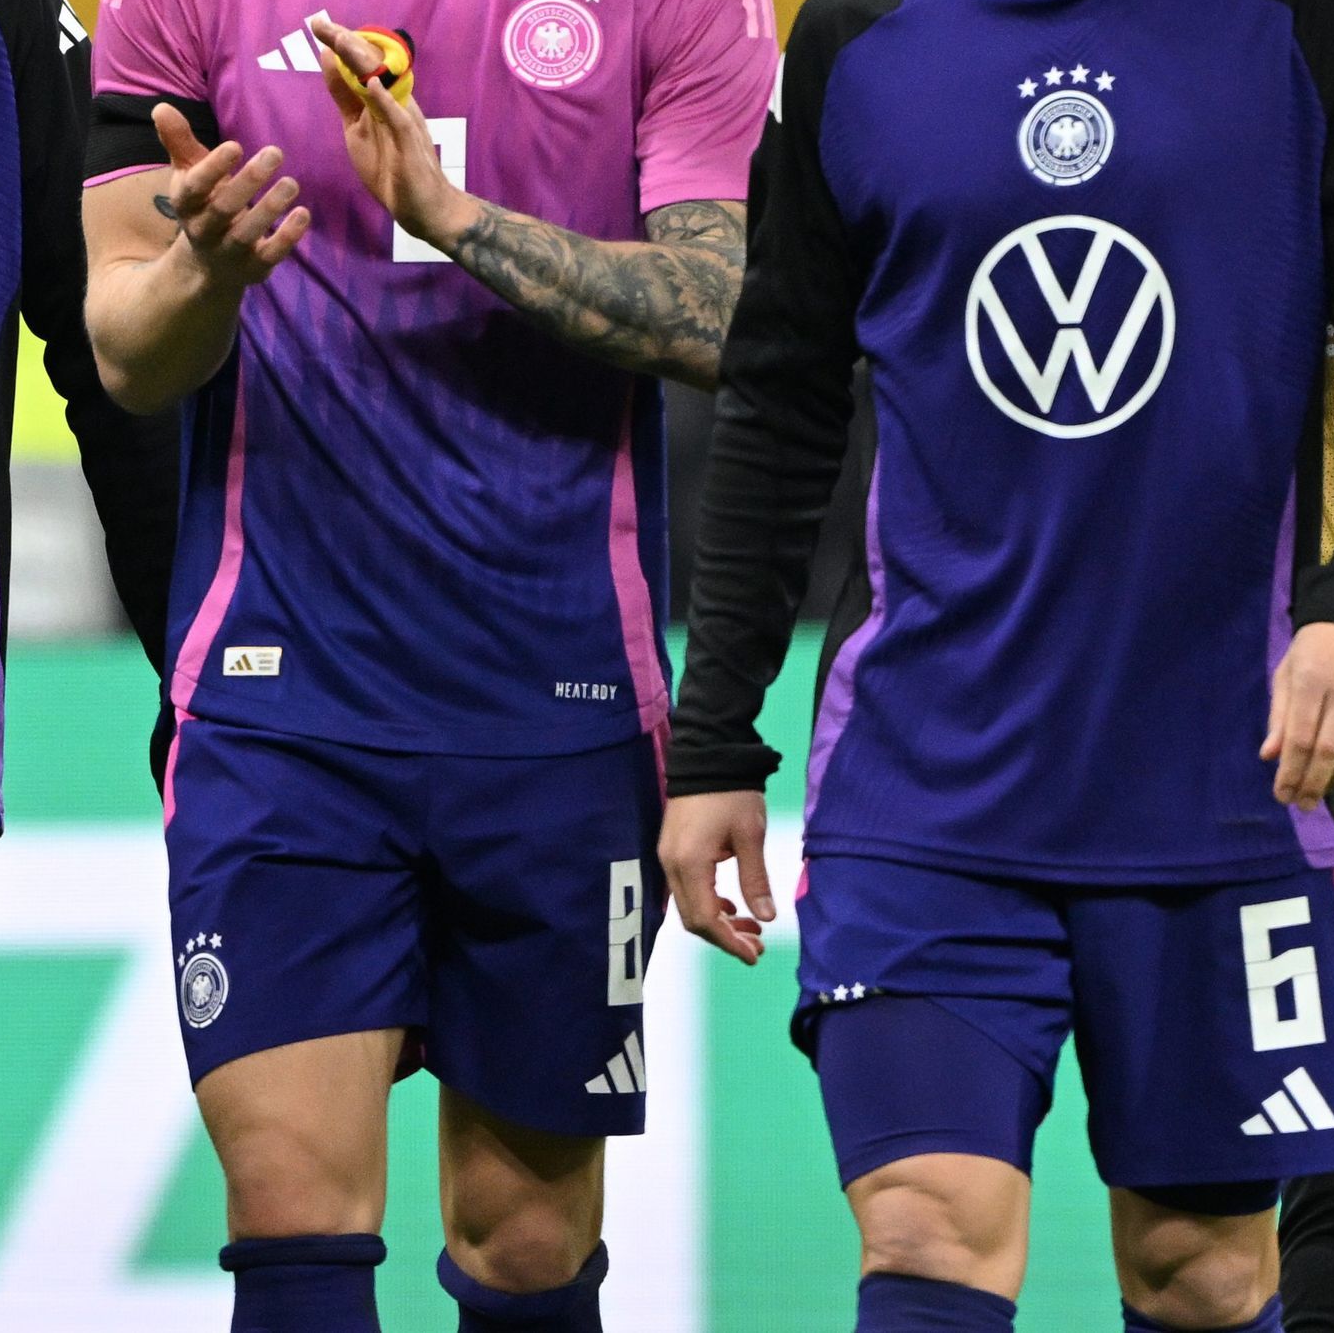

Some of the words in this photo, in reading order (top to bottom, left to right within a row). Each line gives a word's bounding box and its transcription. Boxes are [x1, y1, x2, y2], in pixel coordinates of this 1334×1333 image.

[554, 681, 619, 701] HEAT.RDY
[607, 858, 644, 1007] 8
[1239, 895, 1327, 1052] 6
